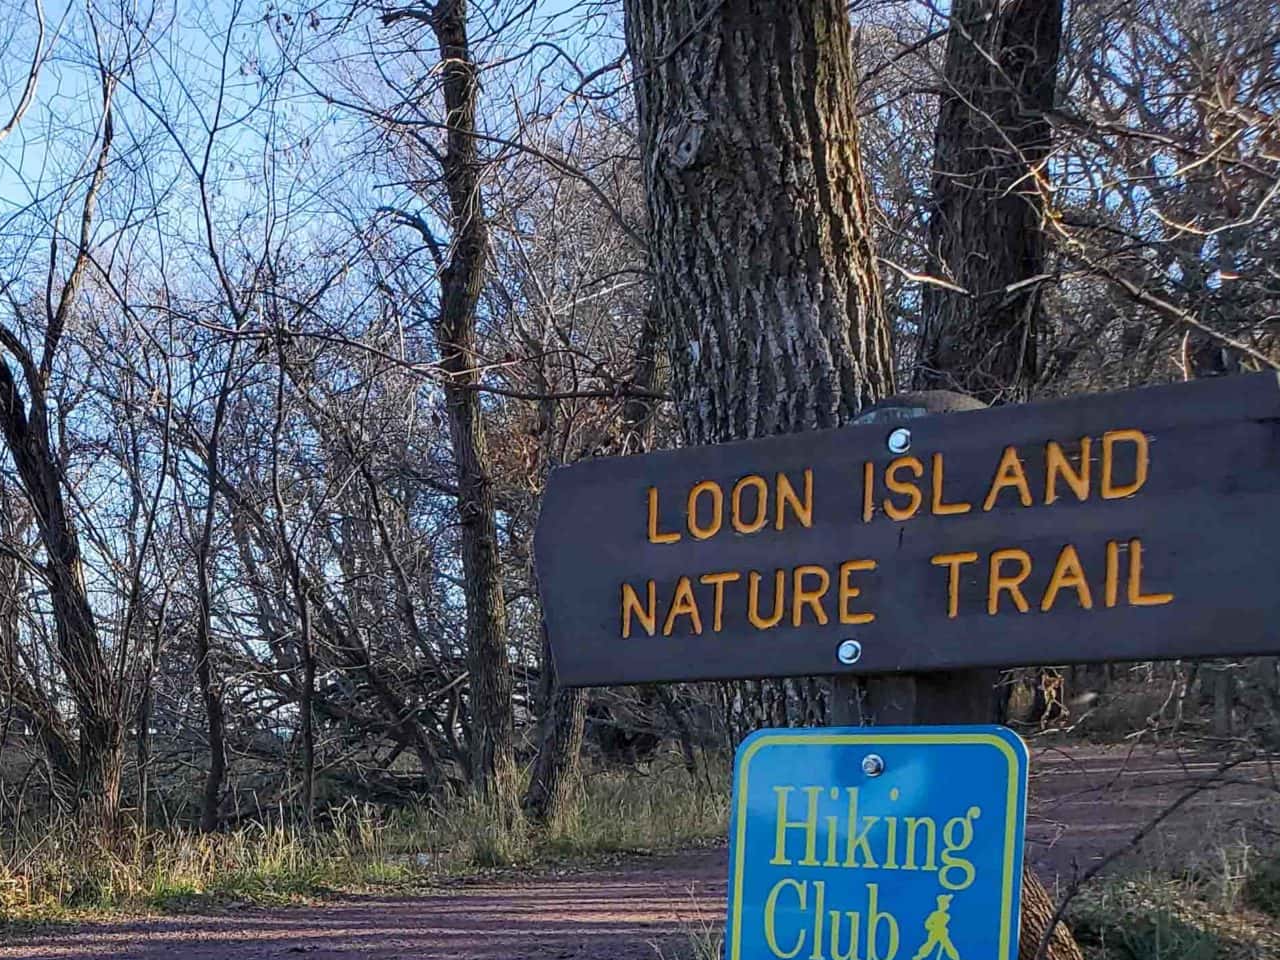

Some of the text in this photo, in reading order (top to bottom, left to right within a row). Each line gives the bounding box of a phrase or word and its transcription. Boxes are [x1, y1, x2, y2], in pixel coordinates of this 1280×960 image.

[647, 428, 1149, 545] LOON ISLAND
[621, 538, 1174, 639] NATURE TRAIL
[769, 785, 981, 891] Hiking
